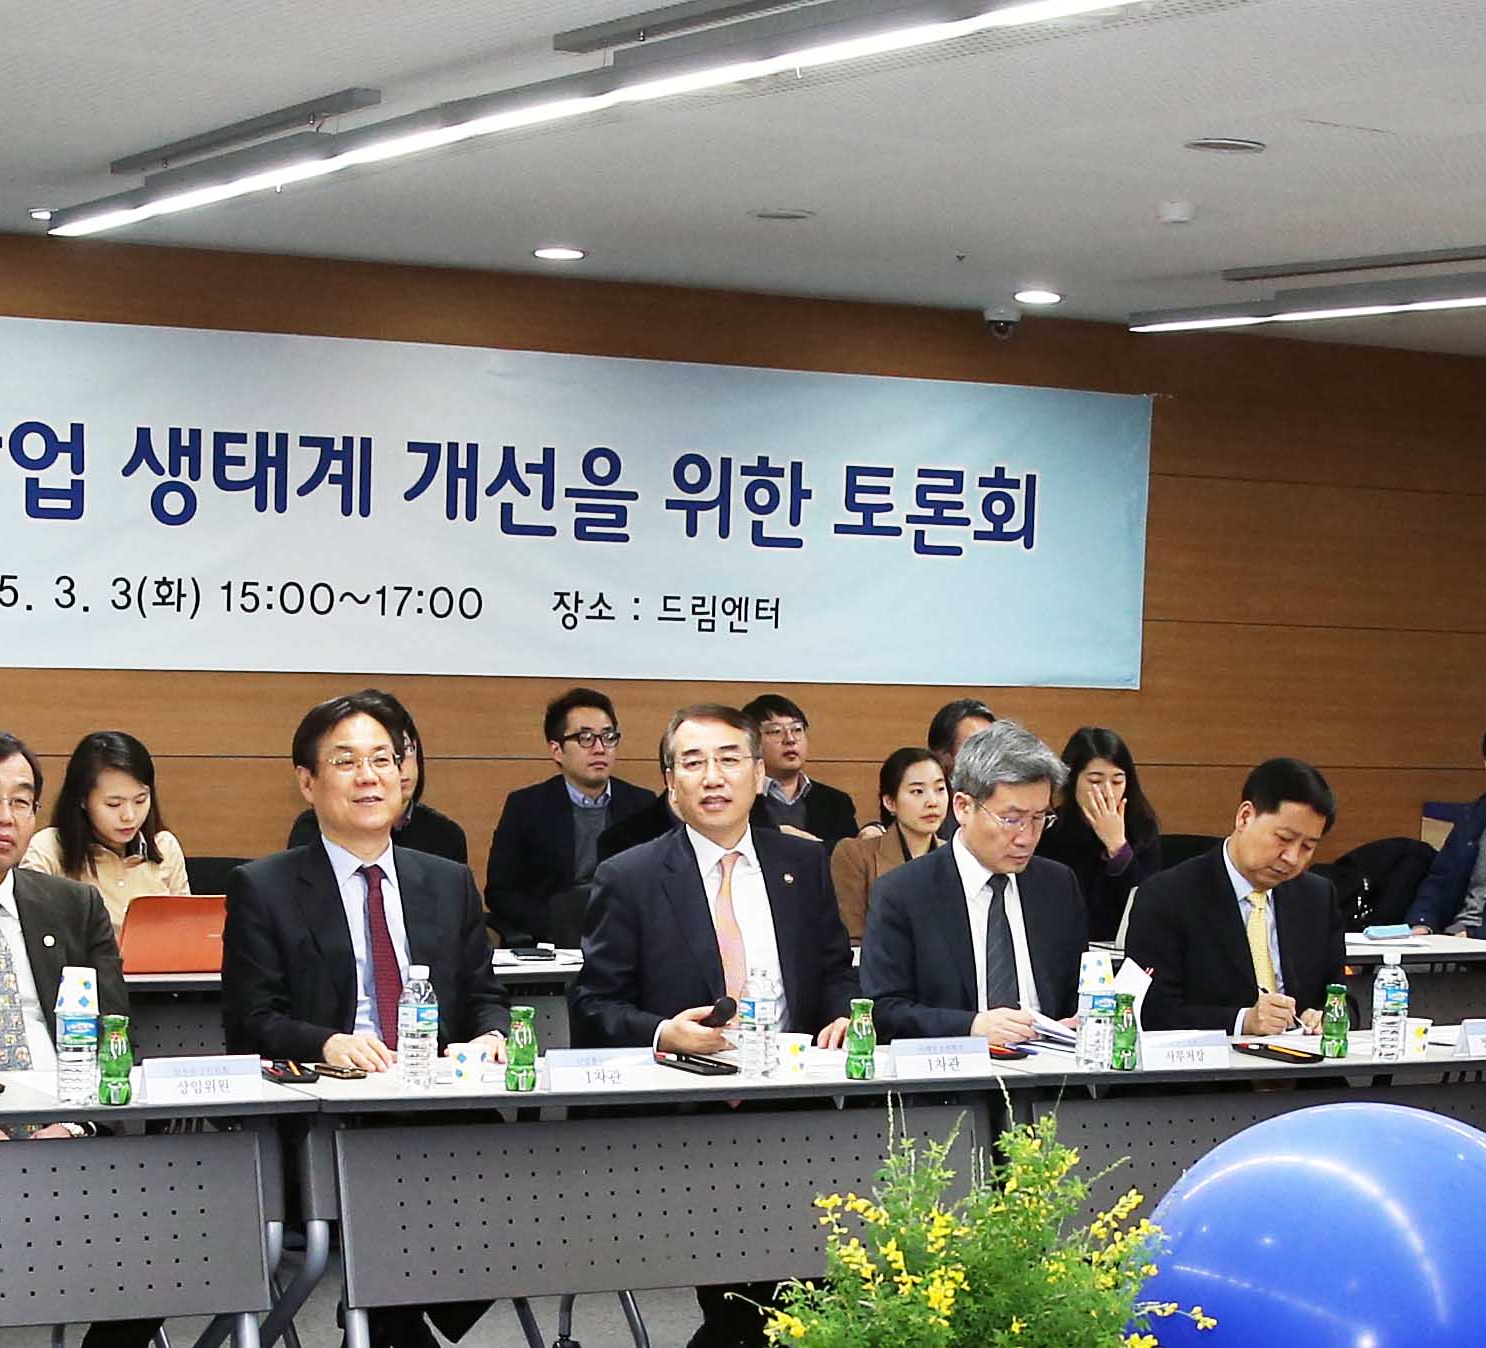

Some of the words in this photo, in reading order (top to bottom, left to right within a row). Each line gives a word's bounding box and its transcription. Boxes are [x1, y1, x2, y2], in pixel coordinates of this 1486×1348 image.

[122, 427, 372, 525] 생태계
[404, 442, 638, 542] 개선을
[666, 454, 812, 548] 위한
[834, 466, 1036, 556] 토론회
[55, 576, 89, 612] 3.
[112, 576, 200, 619] 3(화)
[221, 581, 482, 619] 15:00~17:00
[553, 591, 615, 630] 장소
[658, 596, 779, 633] 드림엔터
[176, 1079, 231, 1095] 상임위원
